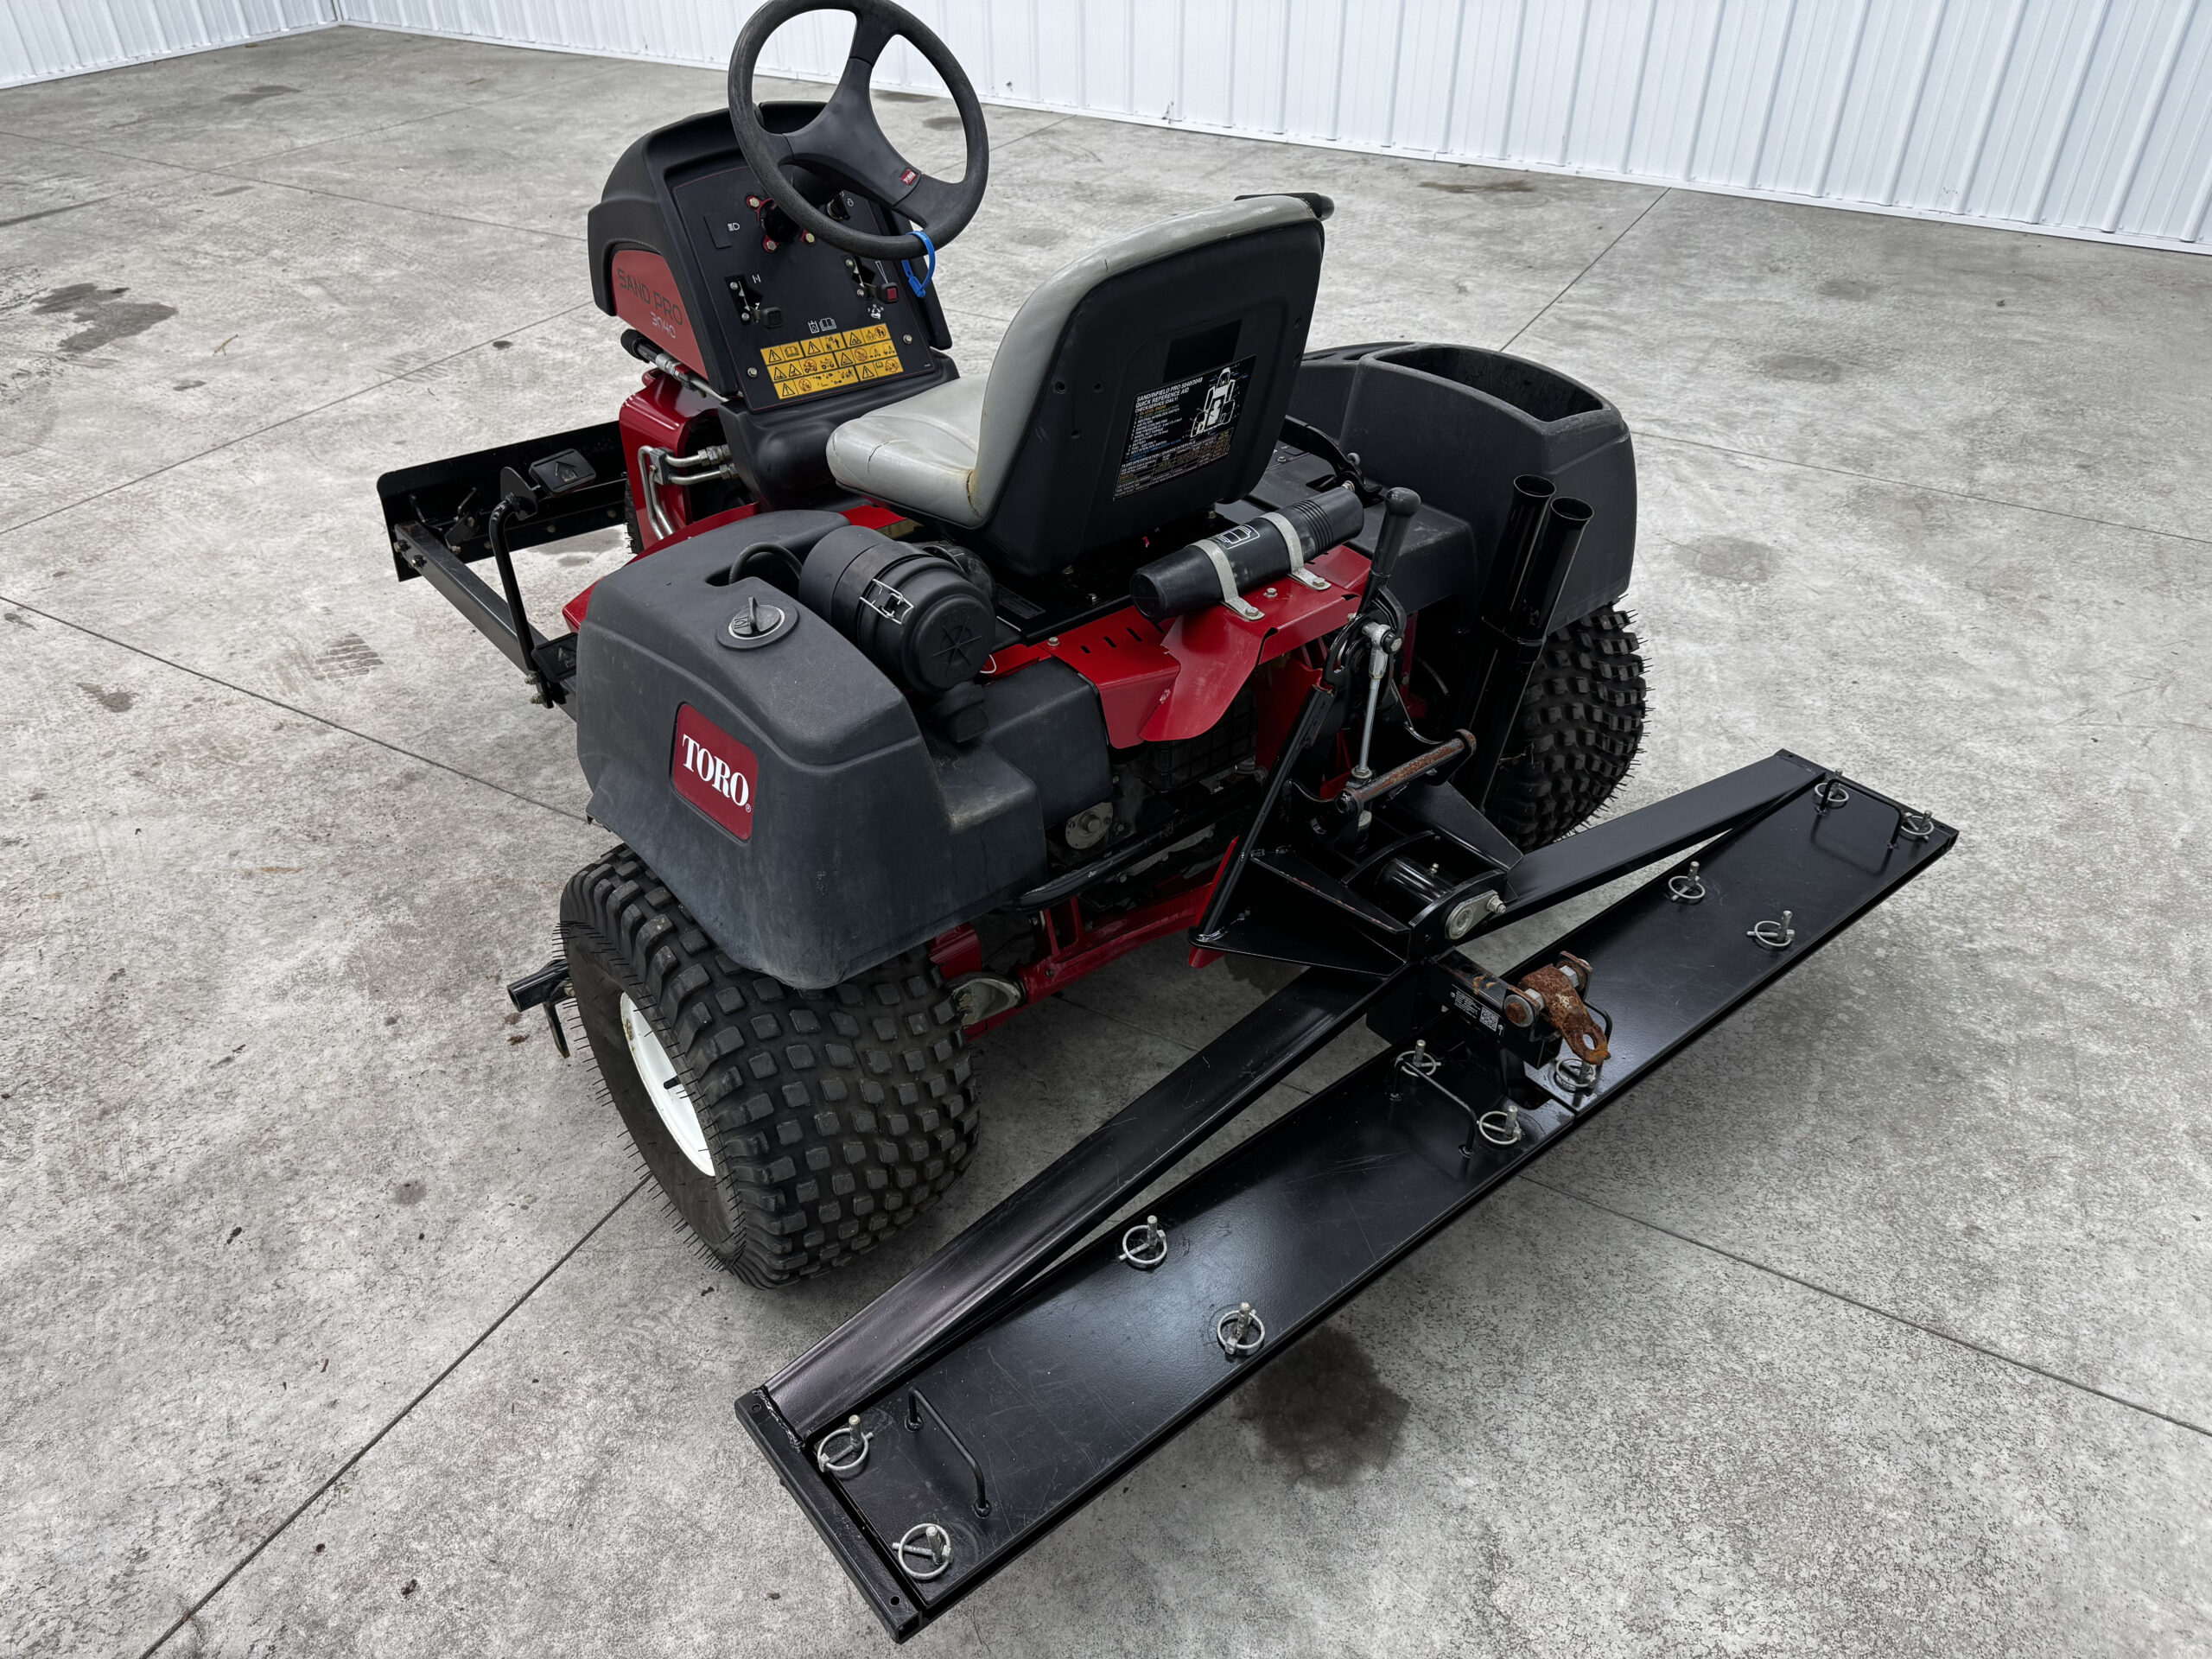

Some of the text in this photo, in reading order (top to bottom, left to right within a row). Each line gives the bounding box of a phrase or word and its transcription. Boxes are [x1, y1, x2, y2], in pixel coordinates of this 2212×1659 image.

[618, 268, 683, 325] SAND PRO
[651, 311, 676, 339] 3040
[1135, 399, 1151, 408] QUICK
[683, 734, 748, 806] TORO
